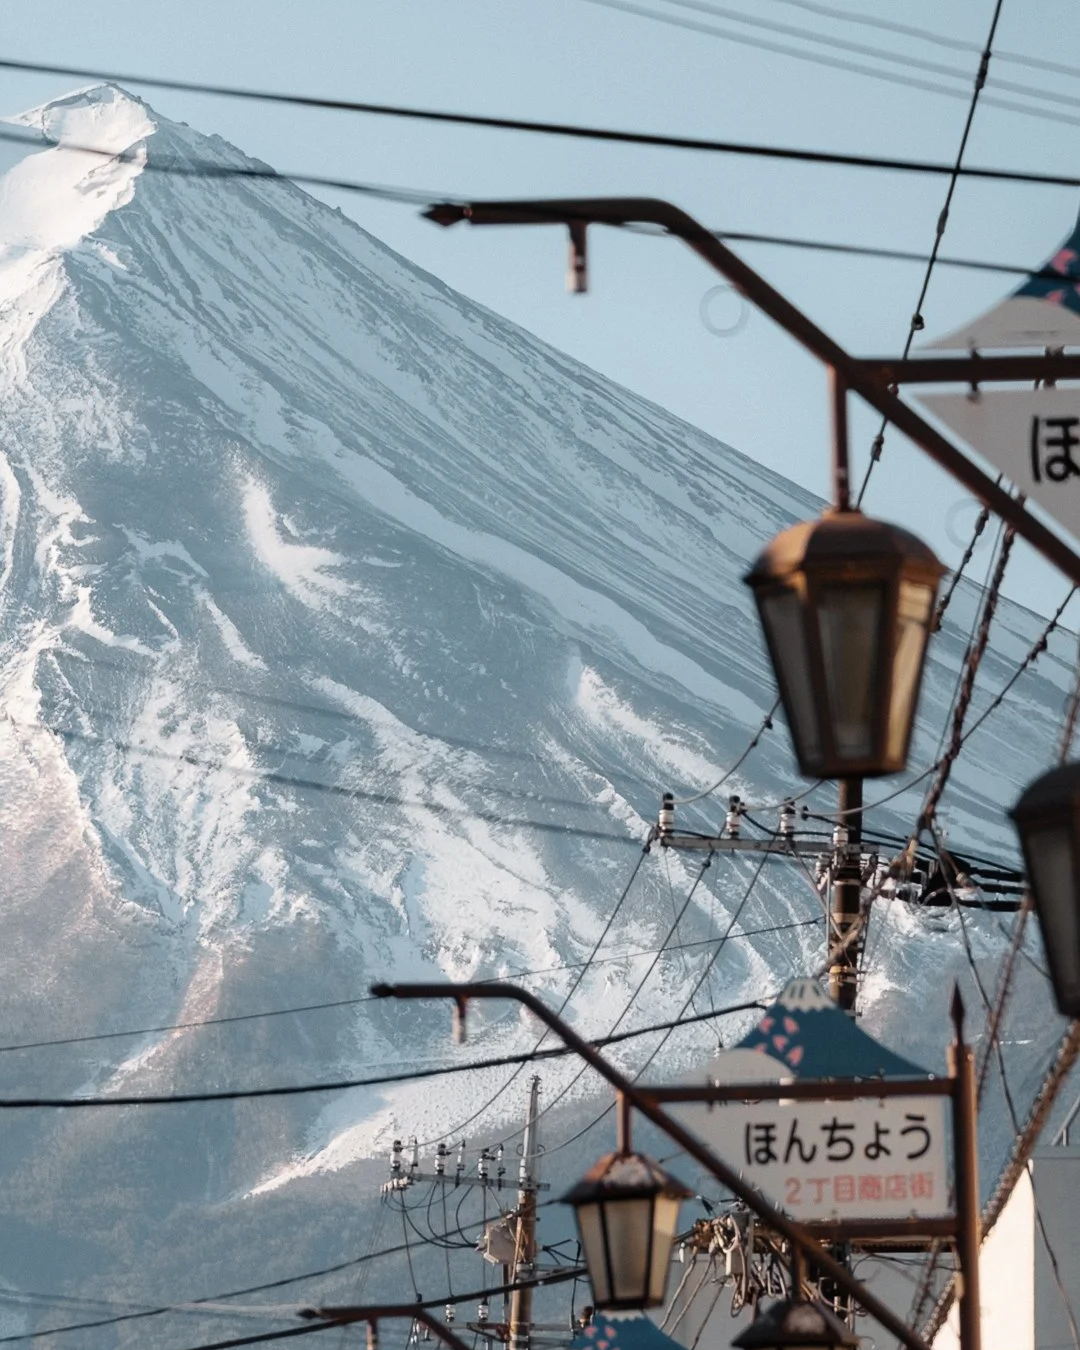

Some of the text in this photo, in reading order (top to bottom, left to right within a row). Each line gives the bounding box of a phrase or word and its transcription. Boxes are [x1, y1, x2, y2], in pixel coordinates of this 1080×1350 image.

[745, 1113, 932, 1166] ほんちょう
